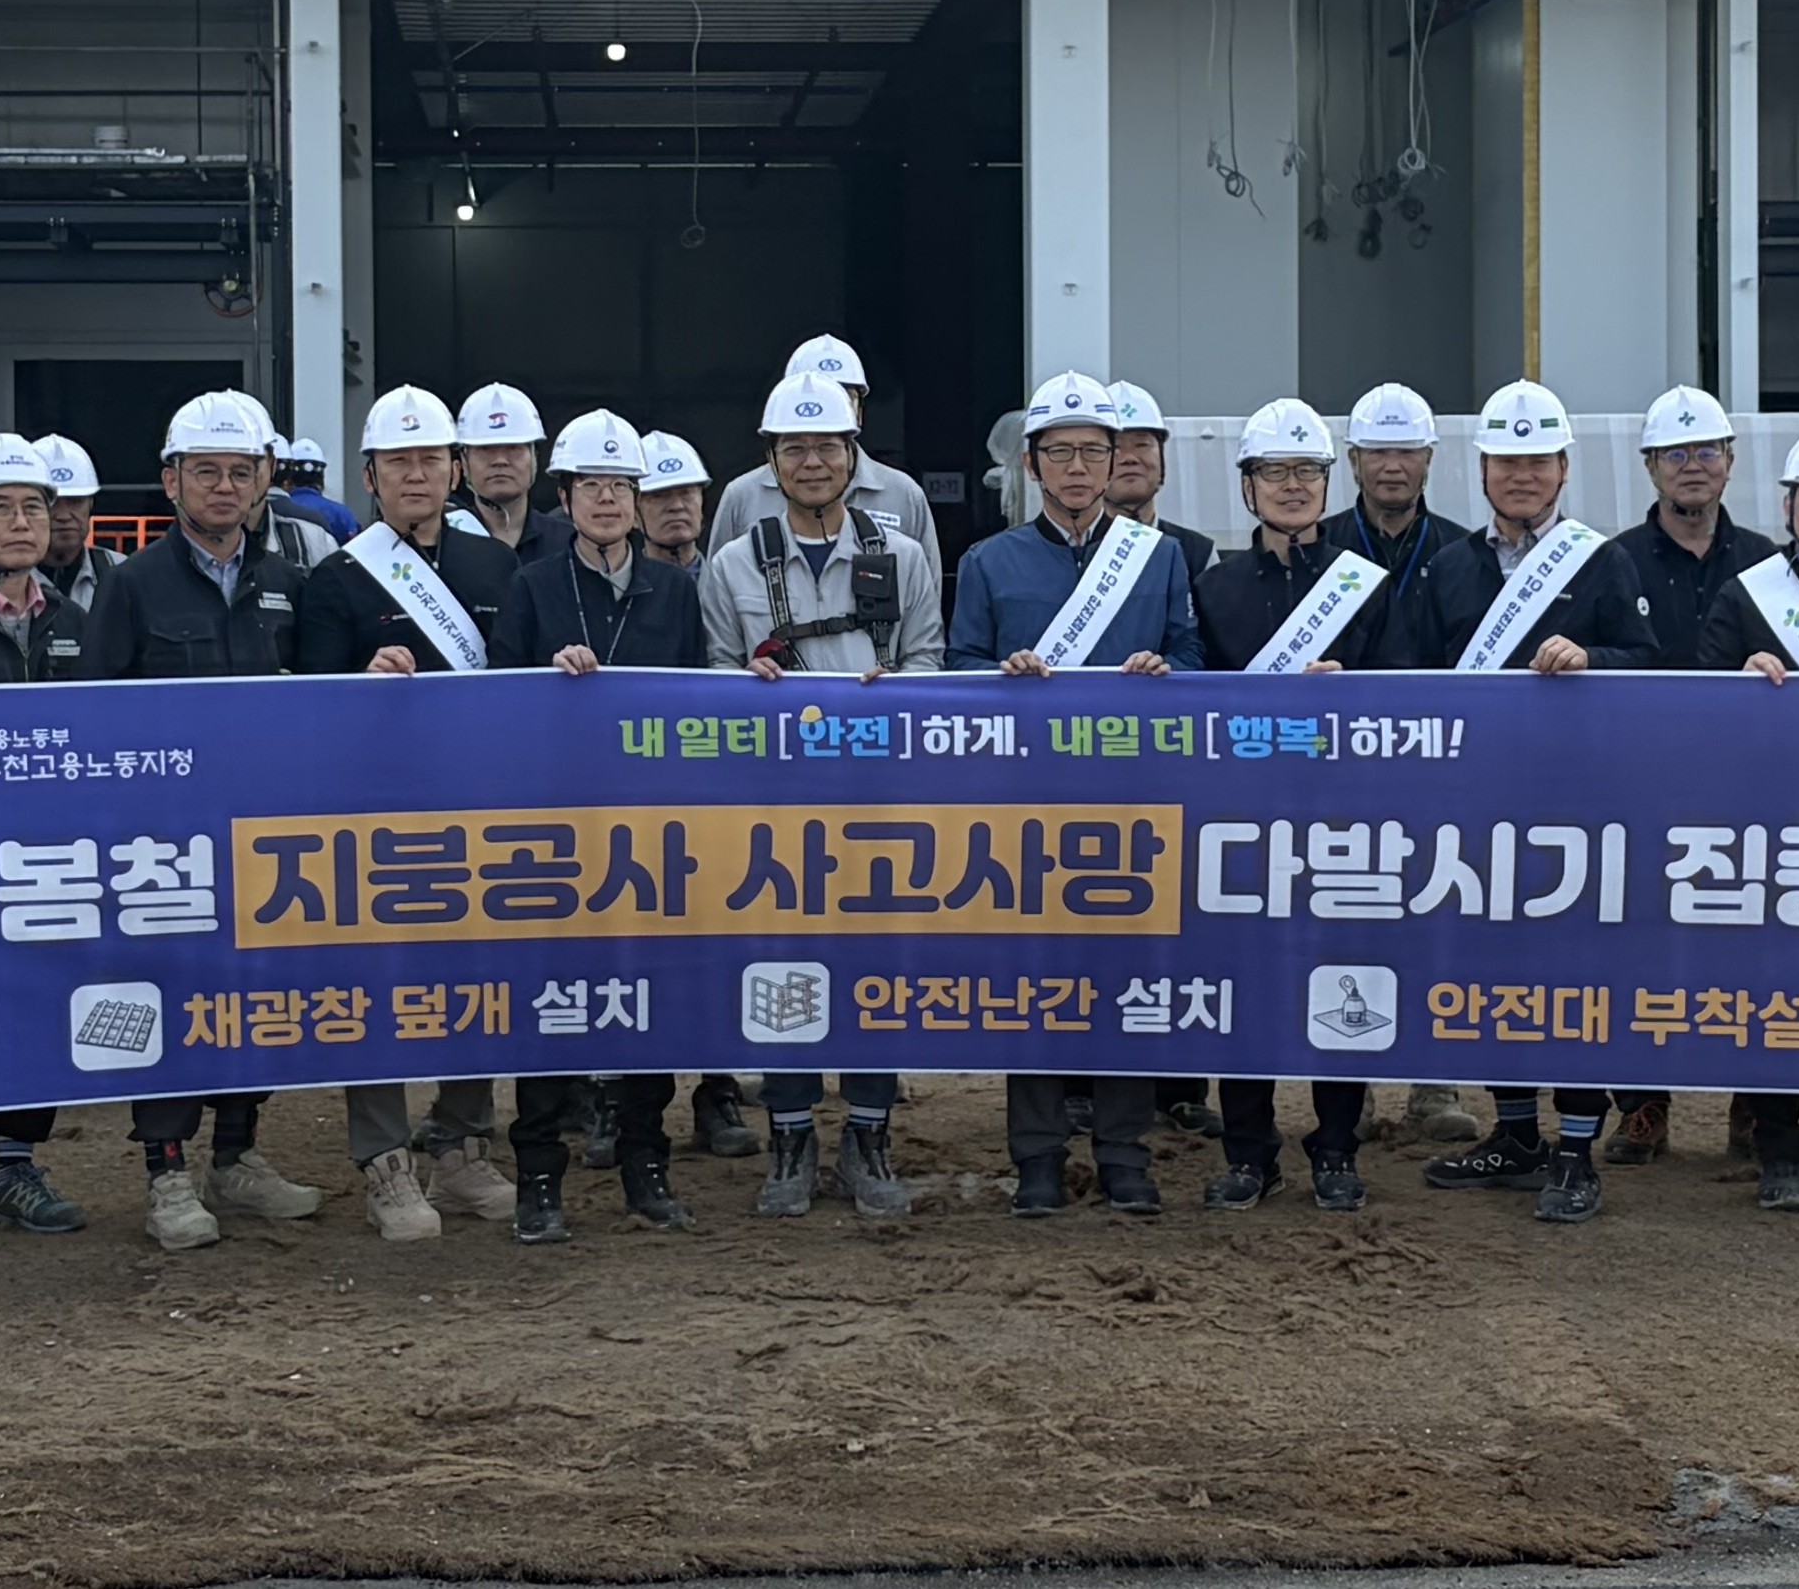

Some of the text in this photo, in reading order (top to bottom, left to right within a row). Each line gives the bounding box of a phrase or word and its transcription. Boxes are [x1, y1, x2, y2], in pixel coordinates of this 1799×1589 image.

[251, 820, 699, 927] 지붕공사
[725, 818, 1166, 917] 사고사망
[1196, 818, 1627, 925] 다발시기
[182, 978, 650, 1050] 채광창 덮개 설치
[852, 974, 1233, 1035] 안전난간 설치
[1426, 980, 1610, 1045] 안전대
